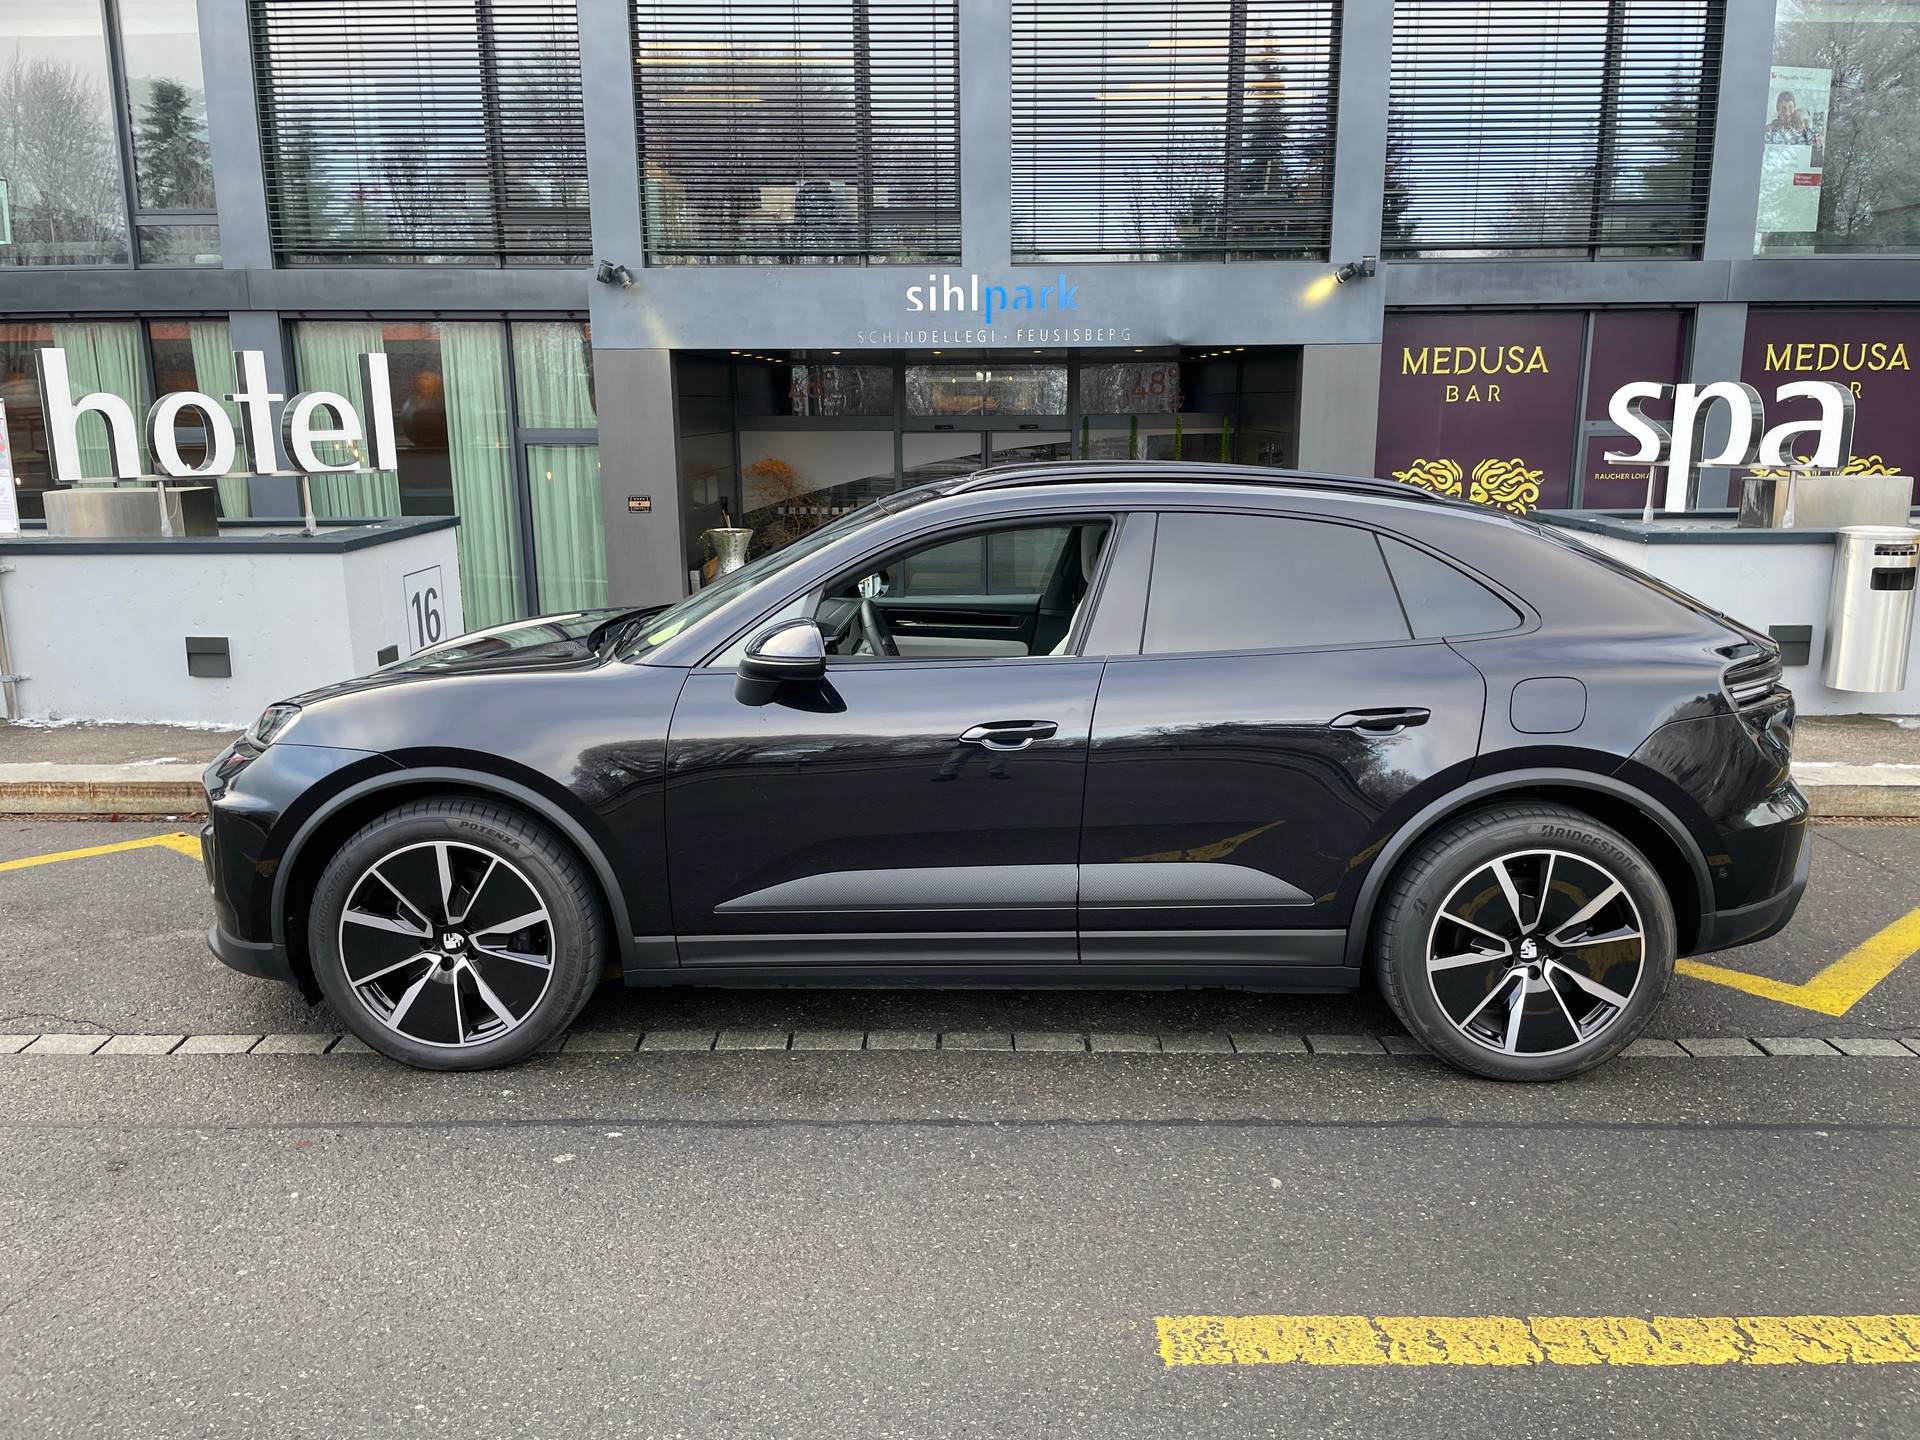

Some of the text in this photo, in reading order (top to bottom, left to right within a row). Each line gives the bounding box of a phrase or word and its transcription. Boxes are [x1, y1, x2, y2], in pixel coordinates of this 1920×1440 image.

[906, 274, 1078, 326] sihlpark
[857, 328, 1131, 344] SCHINDELLEGI FEUSISBERG
[1402, 346, 1549, 375] MEDUSA
[1764, 343, 1910, 372] MEDUSA
[1446, 385, 1501, 402] BAR
[36, 348, 397, 481] hotel
[1604, 381, 1855, 512] spa
[412, 587, 441, 647] 16
[459, 821, 521, 850] POTENZA
[1541, 824, 1641, 874] BRIDGESTONE
